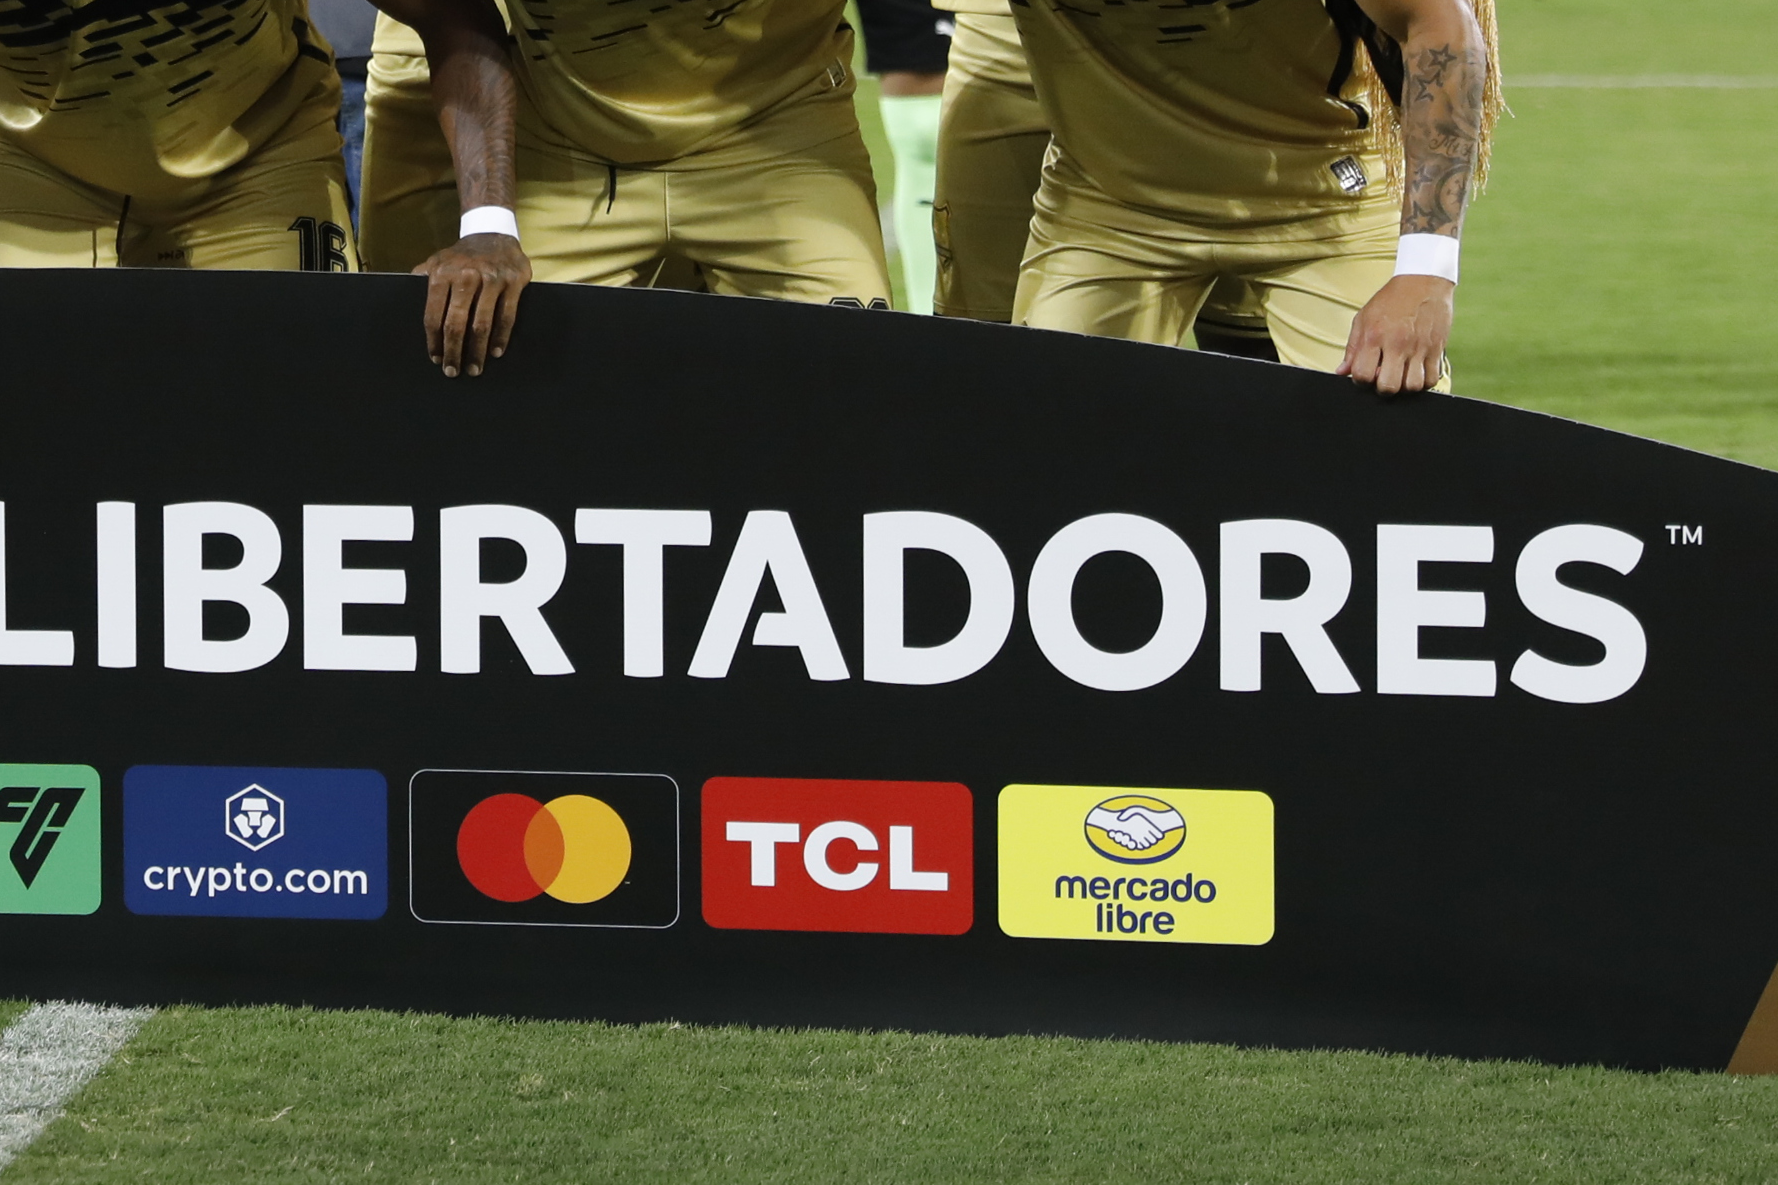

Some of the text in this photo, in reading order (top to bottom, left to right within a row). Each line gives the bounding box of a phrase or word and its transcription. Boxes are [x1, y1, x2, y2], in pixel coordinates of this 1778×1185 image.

[288, 216, 349, 272] 16
[725, 820, 949, 892] TCL
[143, 862, 368, 898] crypto.com
[1054, 872, 1217, 904] mercado
[1094, 902, 1176, 935] libre
